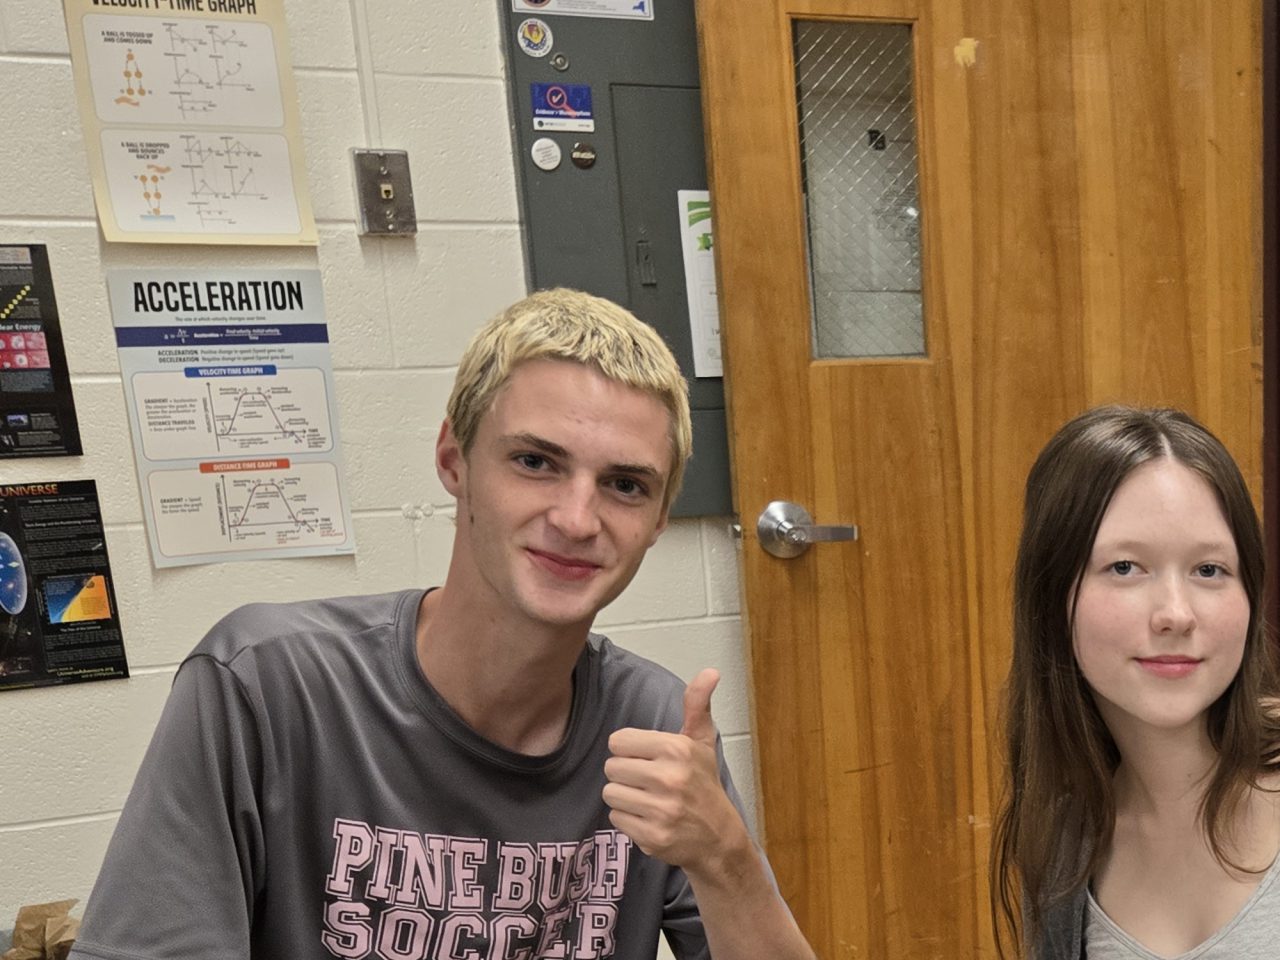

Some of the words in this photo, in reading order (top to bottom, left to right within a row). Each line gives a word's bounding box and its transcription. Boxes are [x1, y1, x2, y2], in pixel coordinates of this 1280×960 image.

[133, 281, 303, 312] ACCELERATION
[257, 461, 278, 469] GRAPH
[0, 484, 58, 497] UNIVERSE
[325, 818, 488, 911] PINE
[491, 829, 633, 913] BUSH
